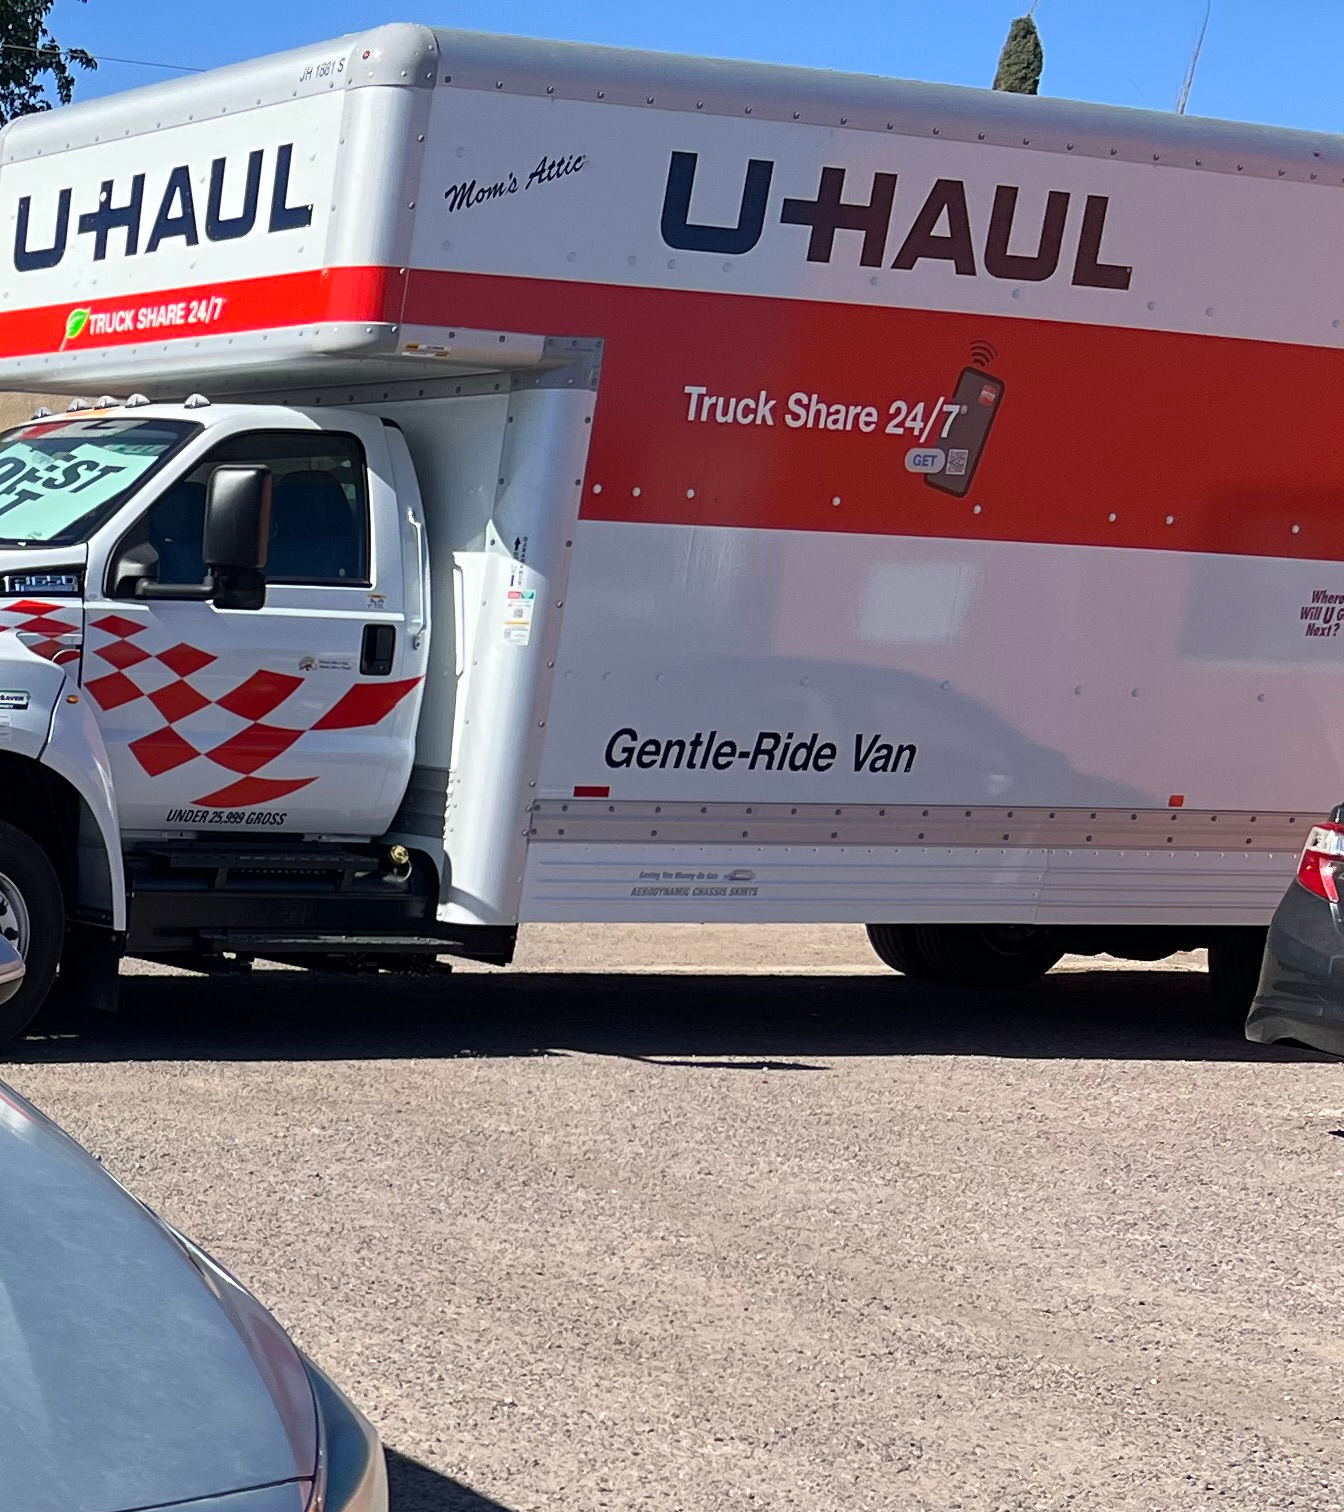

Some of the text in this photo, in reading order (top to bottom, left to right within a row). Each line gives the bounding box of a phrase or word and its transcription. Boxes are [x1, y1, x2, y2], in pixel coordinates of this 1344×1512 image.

[444, 155, 585, 213] Mom's Attic
[13, 142, 314, 273] U-HAUL
[660, 150, 1134, 291] U-HAUL
[88, 294, 226, 336] TRUCK SHARE 24/7
[683, 385, 962, 444] Truck Share 24/7
[911, 454, 939, 468] GET
[1300, 606, 1323, 620] Will
[1323, 606, 1335, 624] U
[604, 727, 918, 773] Gentle-Ride Van
[166, 808, 288, 826] UNDER 25,999 GROSS
